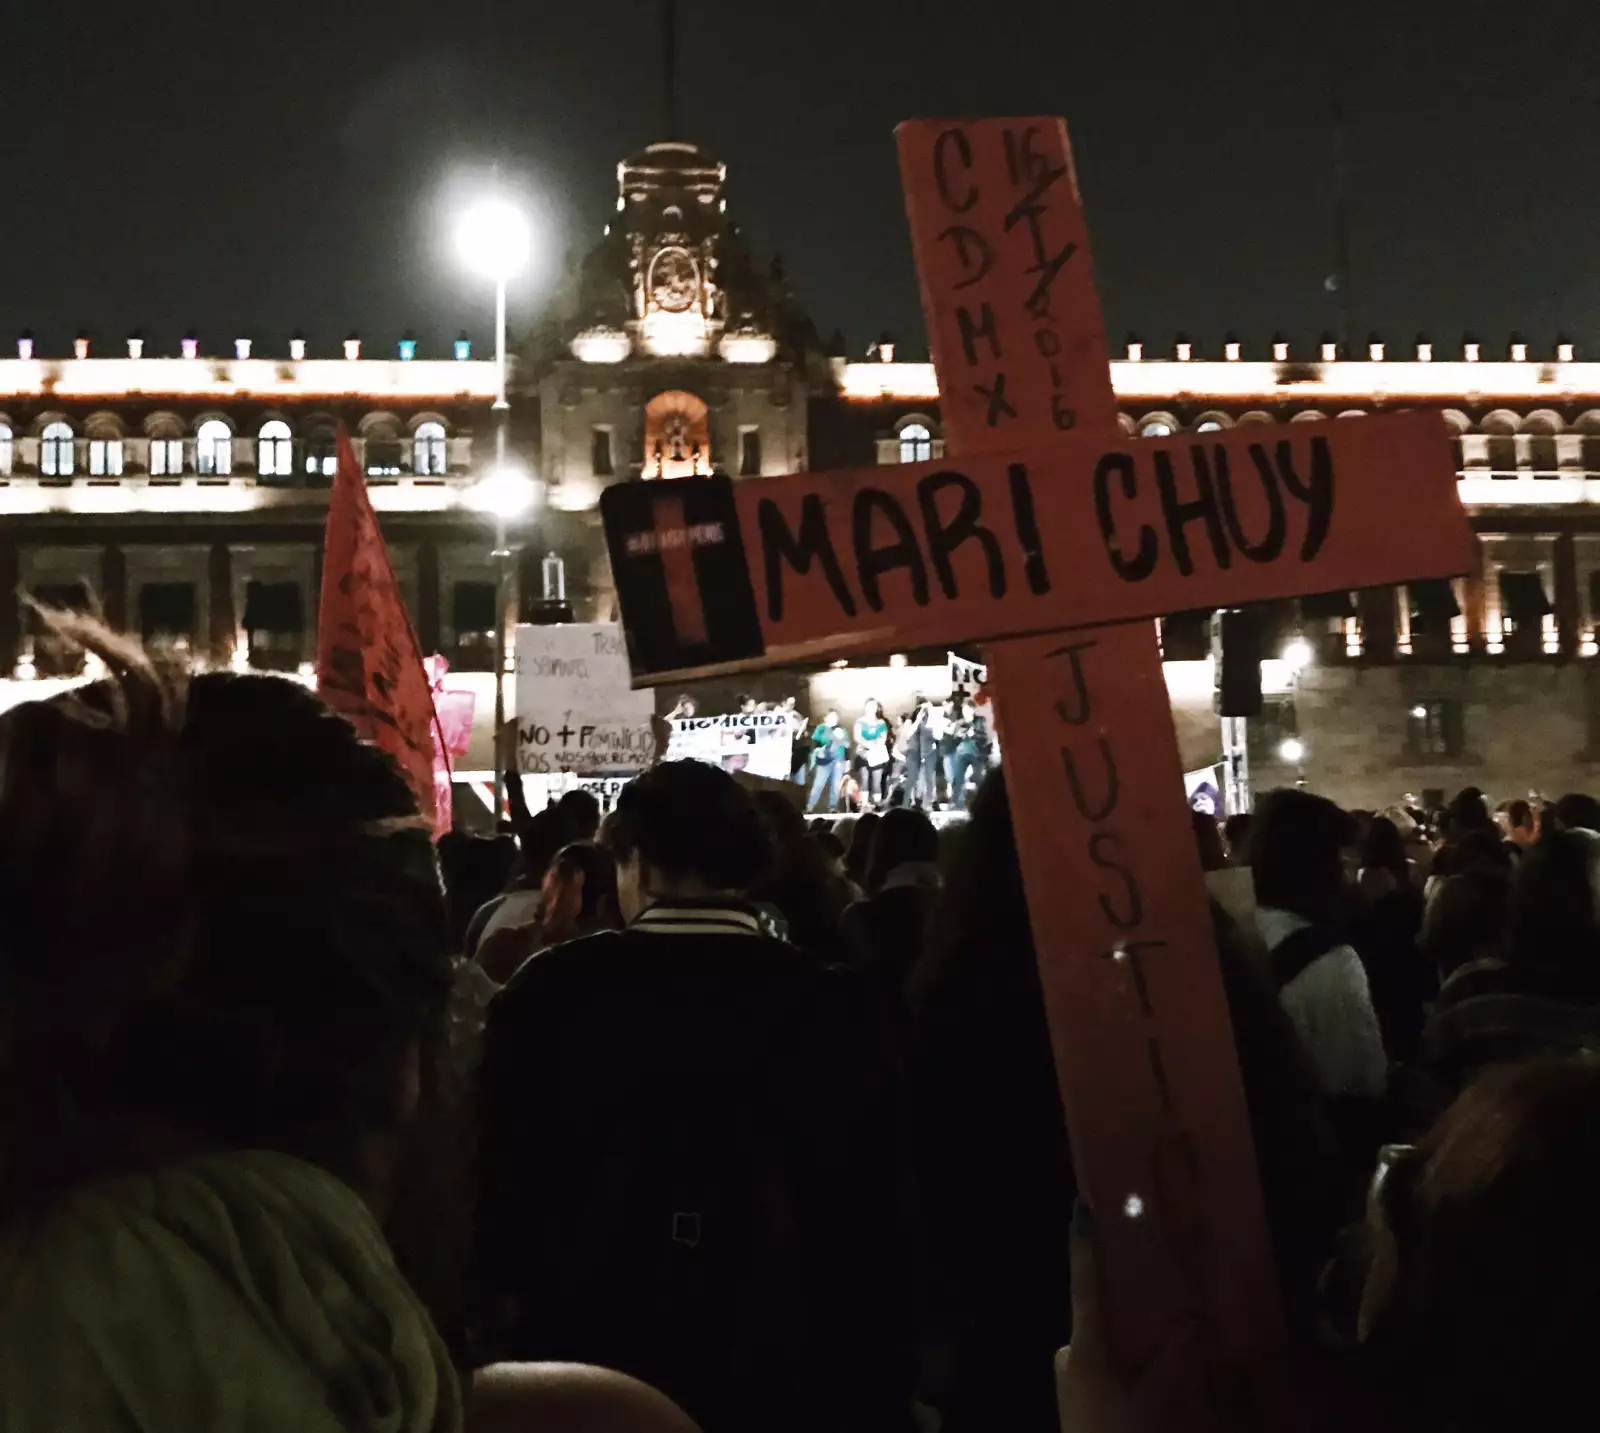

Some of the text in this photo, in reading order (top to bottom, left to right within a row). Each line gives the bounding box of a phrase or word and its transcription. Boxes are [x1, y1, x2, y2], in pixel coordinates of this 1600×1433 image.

[758, 436, 1334, 622] MARI CHUY
[519, 724, 550, 747] NO
